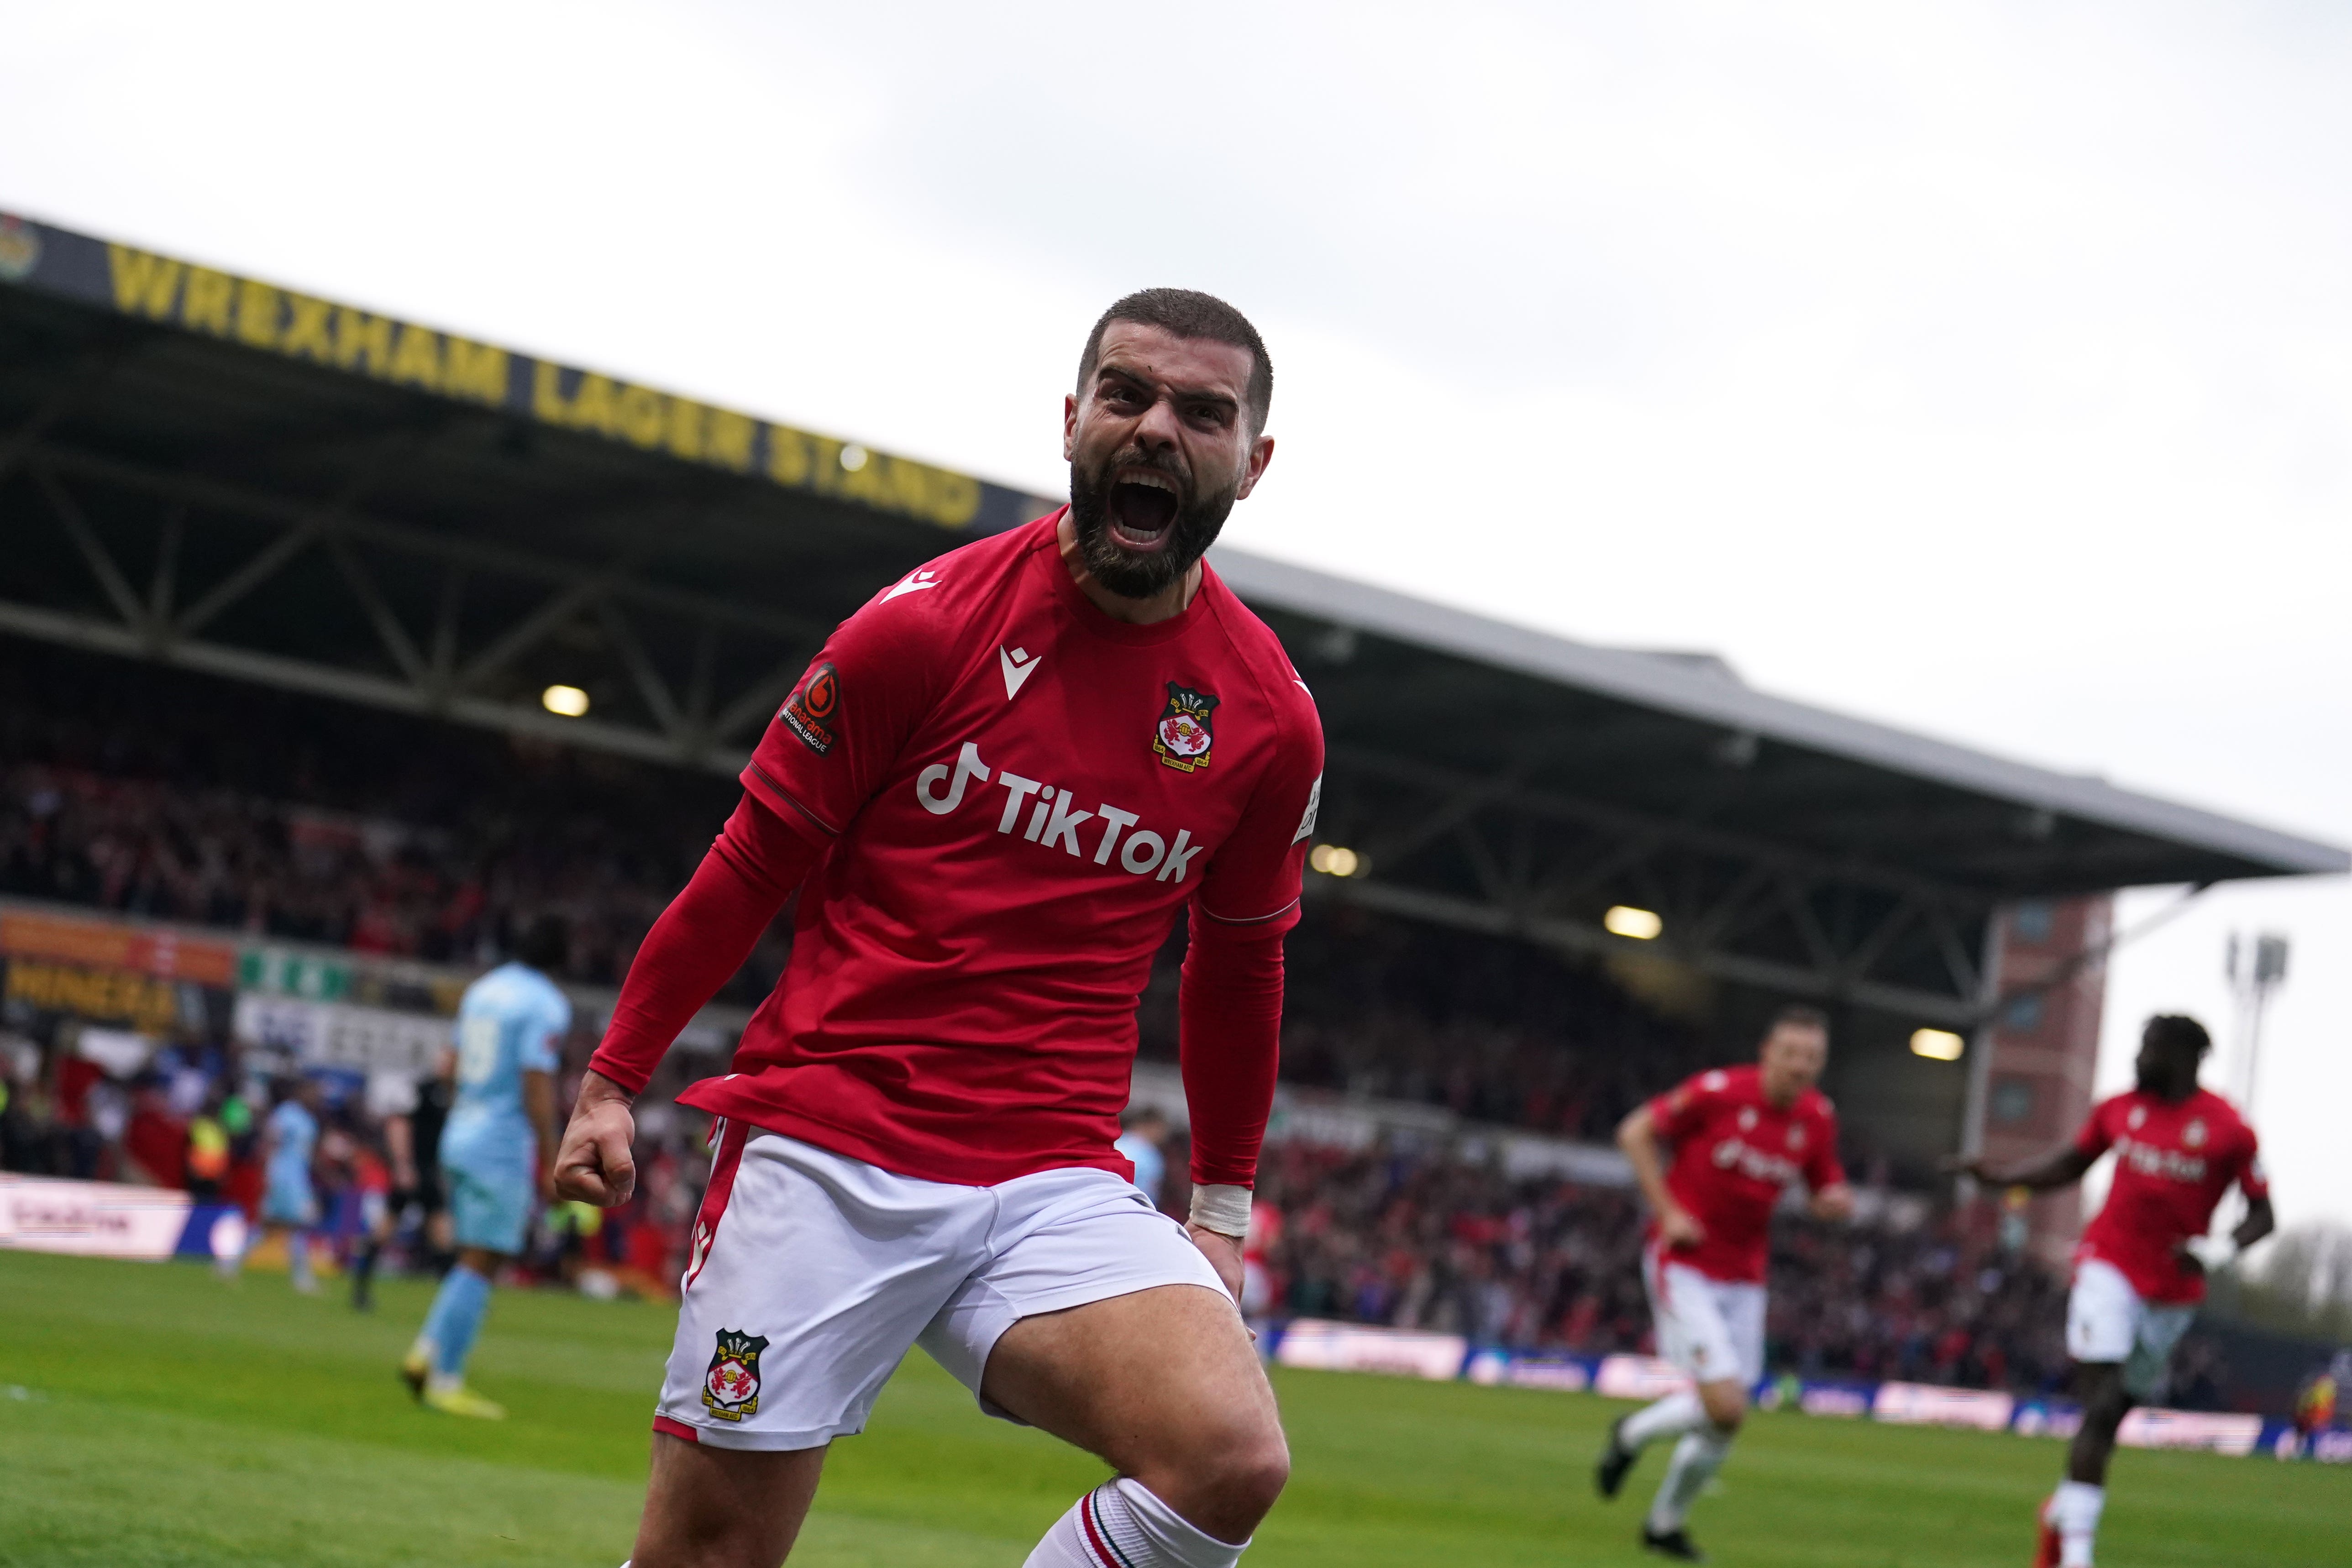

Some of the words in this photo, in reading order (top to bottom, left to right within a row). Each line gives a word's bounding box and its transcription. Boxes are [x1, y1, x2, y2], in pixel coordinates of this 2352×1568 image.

[107, 242, 509, 407] WREXHAM
[532, 357, 757, 474] LAGER
[768, 424, 980, 530] STAND
[782, 708, 803, 734] NATIONAL
[803, 729, 827, 752] LEAGUE
[1164, 758, 1183, 768] WREXHAM
[997, 771, 1204, 883] TikTok
